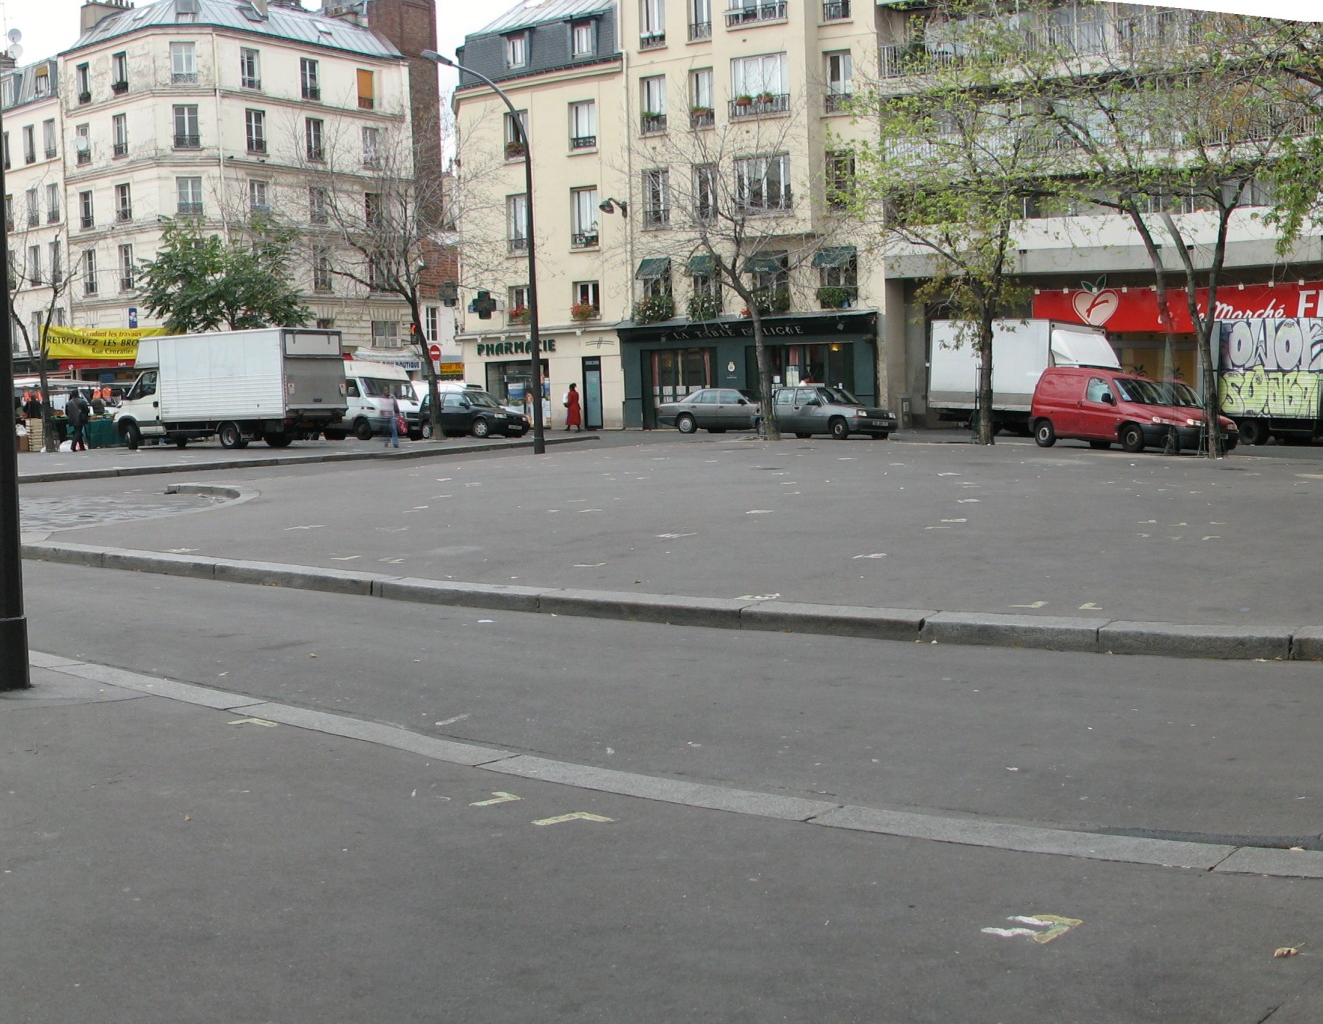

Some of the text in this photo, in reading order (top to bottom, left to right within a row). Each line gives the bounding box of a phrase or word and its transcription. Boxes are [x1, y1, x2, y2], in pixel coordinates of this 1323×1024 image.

[673, 332, 689, 340] LA
[741, 326, 804, 336] D'LIGRE
[46, 336, 98, 346] RETROUVEZ
